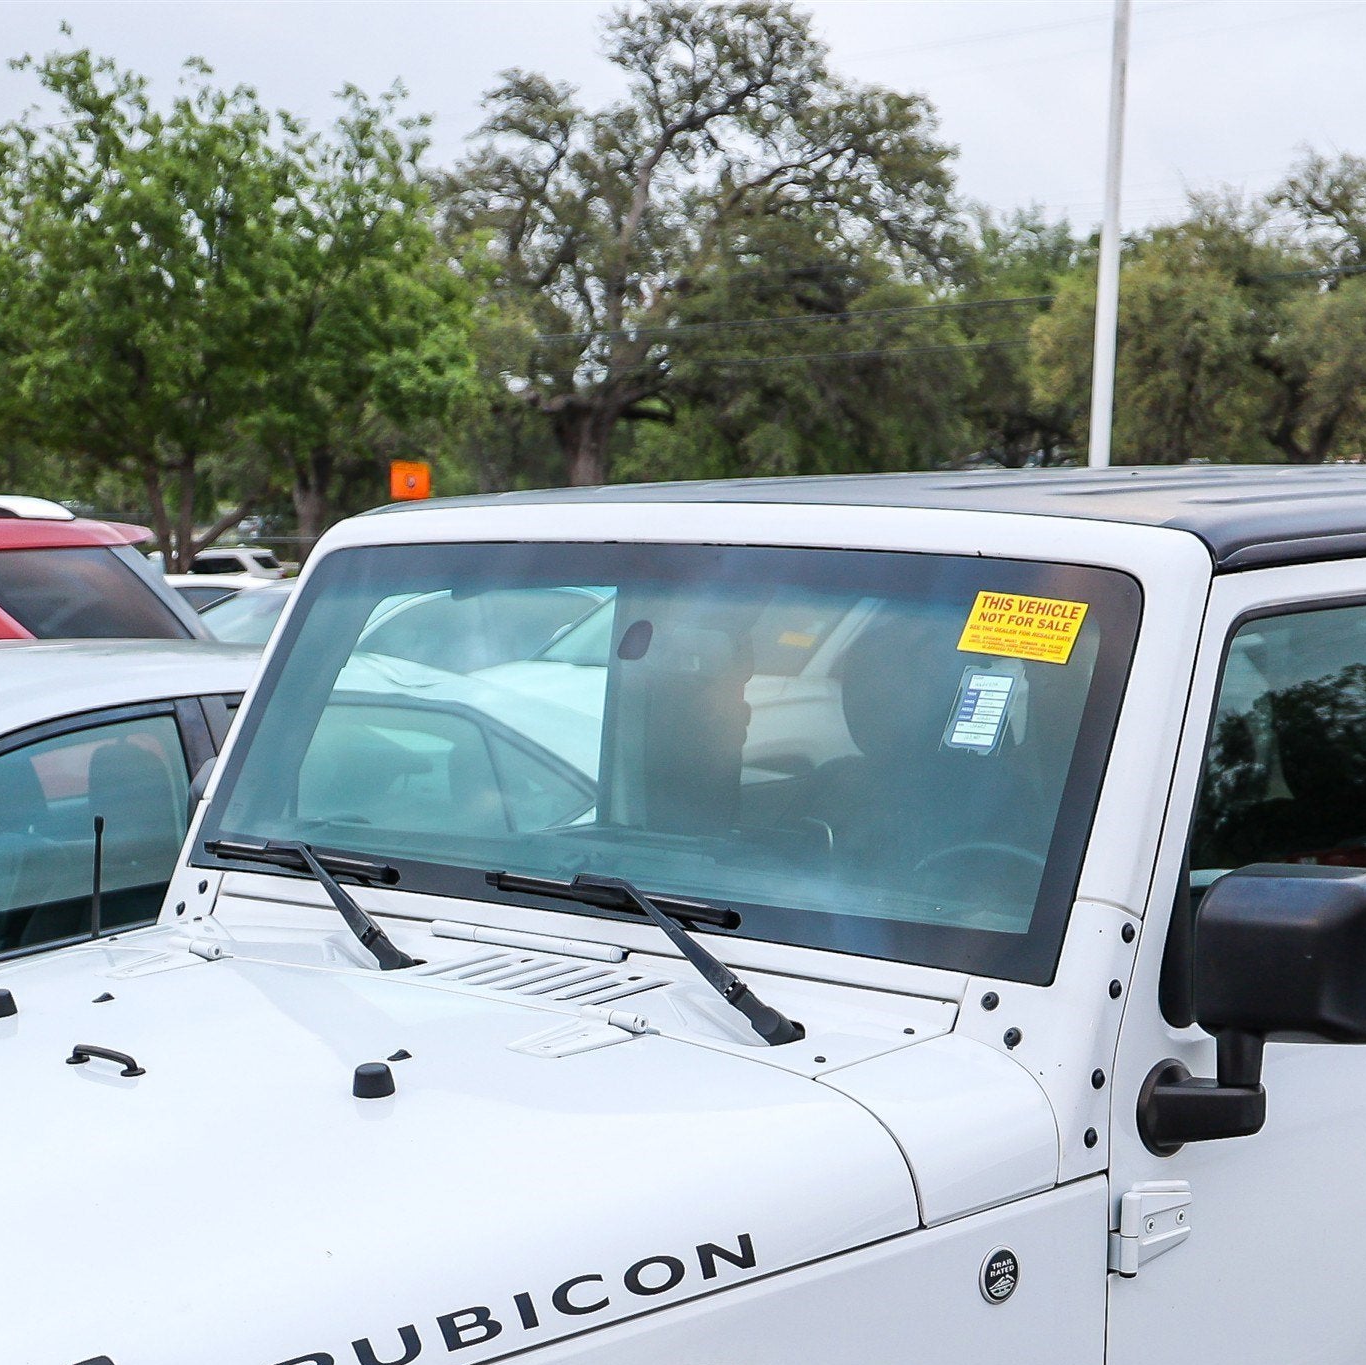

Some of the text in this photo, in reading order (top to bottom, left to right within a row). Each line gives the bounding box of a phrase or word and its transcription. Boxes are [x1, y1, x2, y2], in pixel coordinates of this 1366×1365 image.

[981, 595, 1082, 620] THIS VEHICLE
[978, 611, 1072, 633] NOT FOR SALE
[990, 1264, 1015, 1278] RATED
[992, 1258, 1013, 1270] TRAIL
